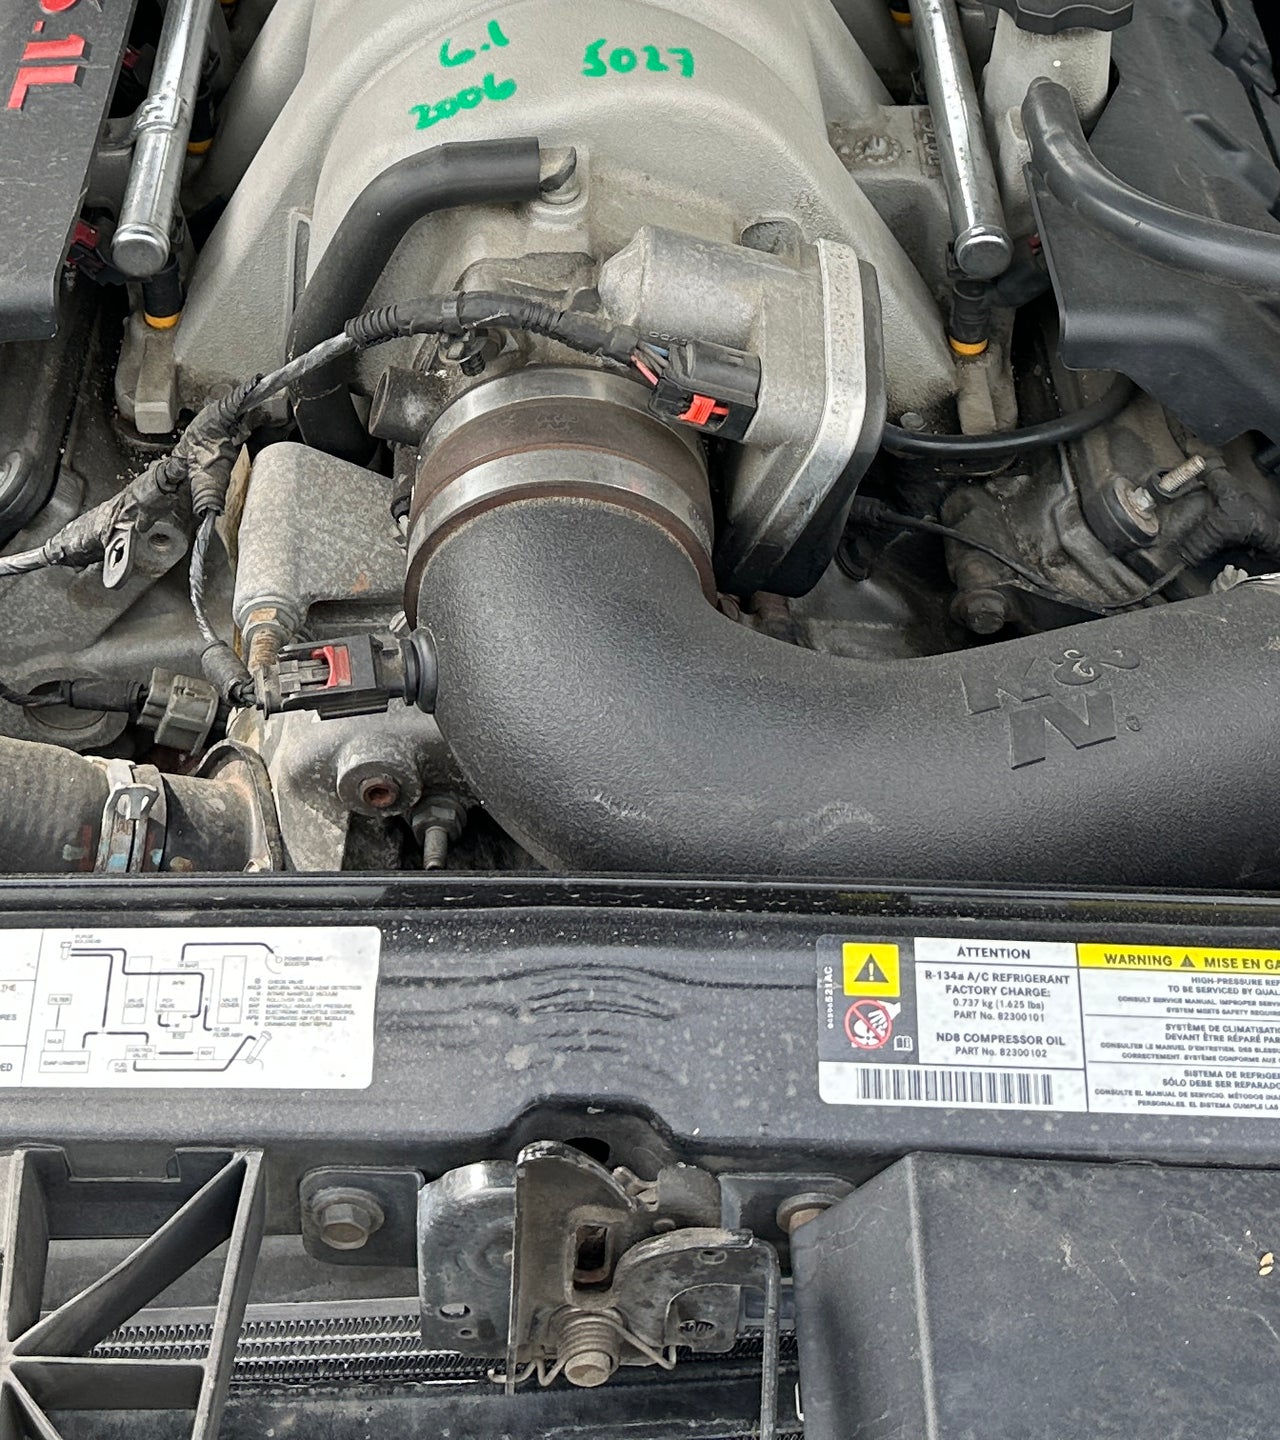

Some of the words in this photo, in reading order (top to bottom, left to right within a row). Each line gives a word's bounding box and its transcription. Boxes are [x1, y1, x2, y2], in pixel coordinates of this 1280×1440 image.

[438, 19, 510, 68] 6.1
[581, 38, 696, 79] 5027
[407, 72, 518, 130] 2006
[957, 946, 1031, 959] ATTENTION
[1104, 953, 1172, 966] WARNING
[1204, 957, 1238, 969] MISE
[1242, 958, 1261, 969] EN
[924, 970, 964, 981] R-134a
[967, 971, 989, 984] A/C
[992, 972, 1070, 984] REFRIGERANT
[1191, 976, 1263, 986] HIGH-PRESSURE
[945, 984, 997, 996] FACTORY
[1000, 986, 1051, 998] CHARGE:
[1167, 984, 1181, 993] TO
[1182, 985, 1194, 994] BE
[1195, 986, 1240, 995] SERVICED
[1241, 987, 1253, 996] BY
[981, 998, 994, 1010] kg
[995, 999, 1025, 1010] (1.625
[1027, 1000, 1045, 1012] lbs)
[953, 1010, 977, 1020] PART
[979, 1010, 995, 1021] No.
[997, 1011, 1045, 1023] 82300101
[963, 1033, 1043, 1045] COMPRESSOR
[1045, 1035, 1066, 1047] OIL
[955, 1046, 979, 1056] PART
[981, 1047, 997, 1057] No.
[999, 1047, 1047, 1058] 82300102
